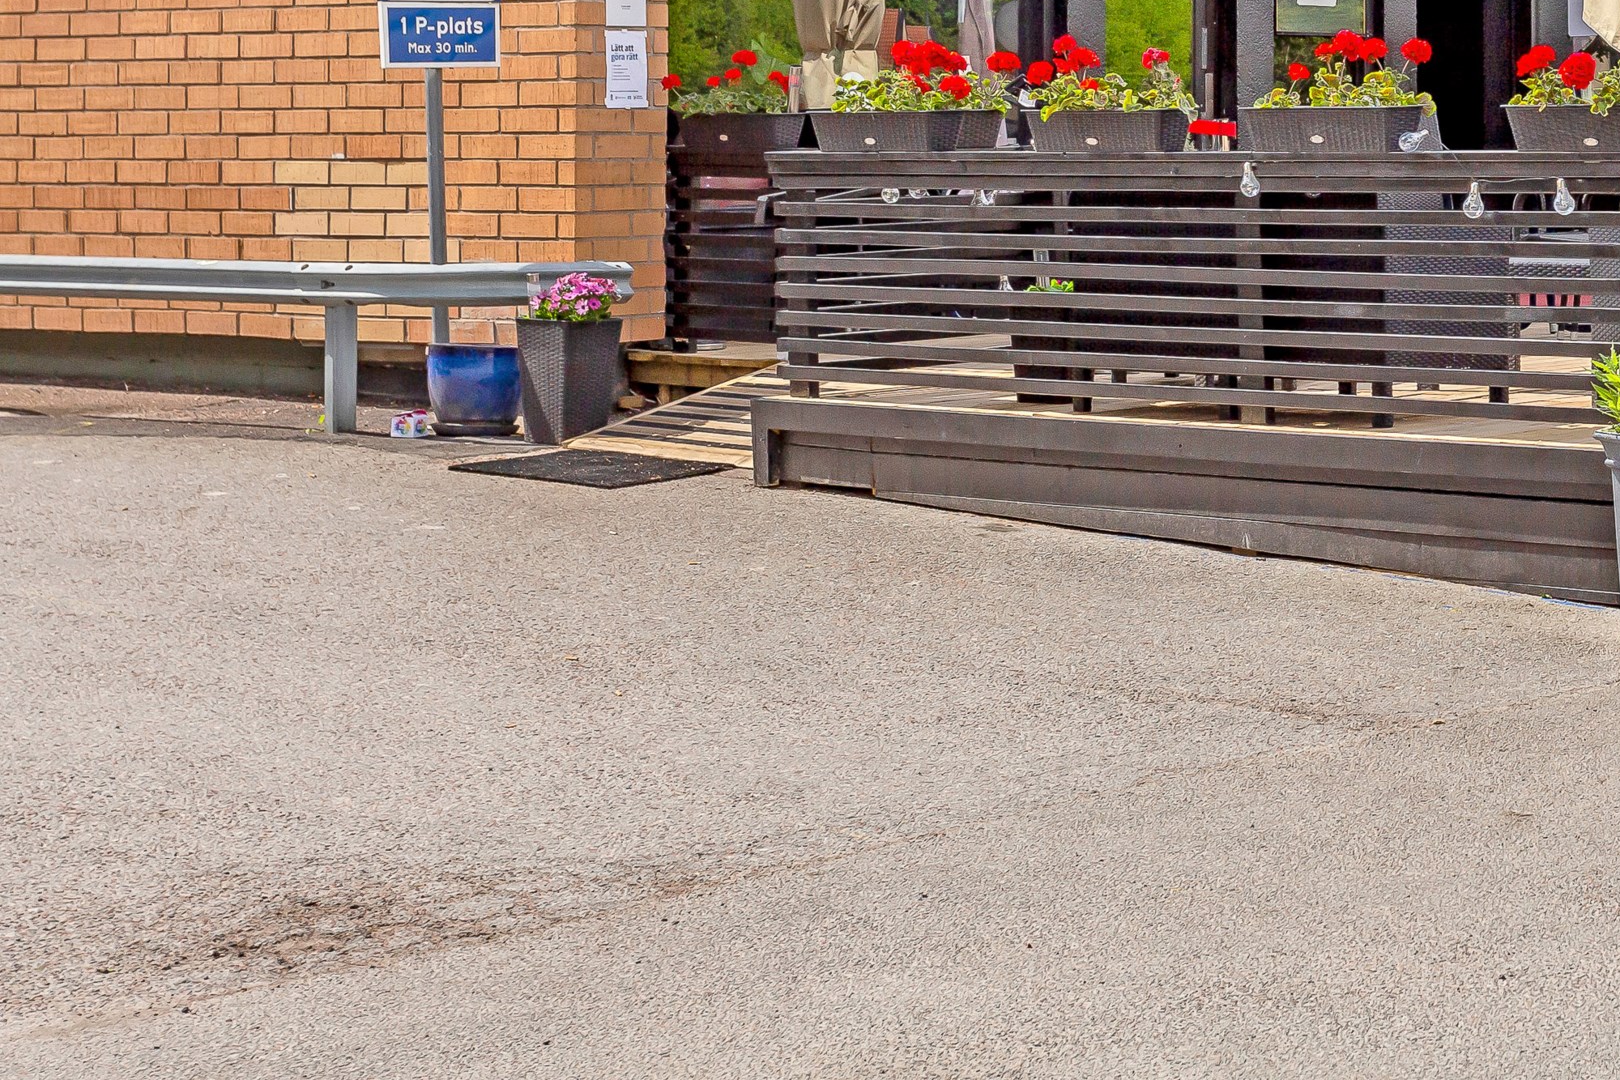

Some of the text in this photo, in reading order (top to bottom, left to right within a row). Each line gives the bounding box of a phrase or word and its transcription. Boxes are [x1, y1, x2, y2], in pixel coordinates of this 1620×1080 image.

[400, 15, 484, 39] 1 P-plats
[408, 41, 478, 54] Max 30 min.
[610, 43, 634, 52] Lätt att
[610, 52, 639, 63] göra rätt
